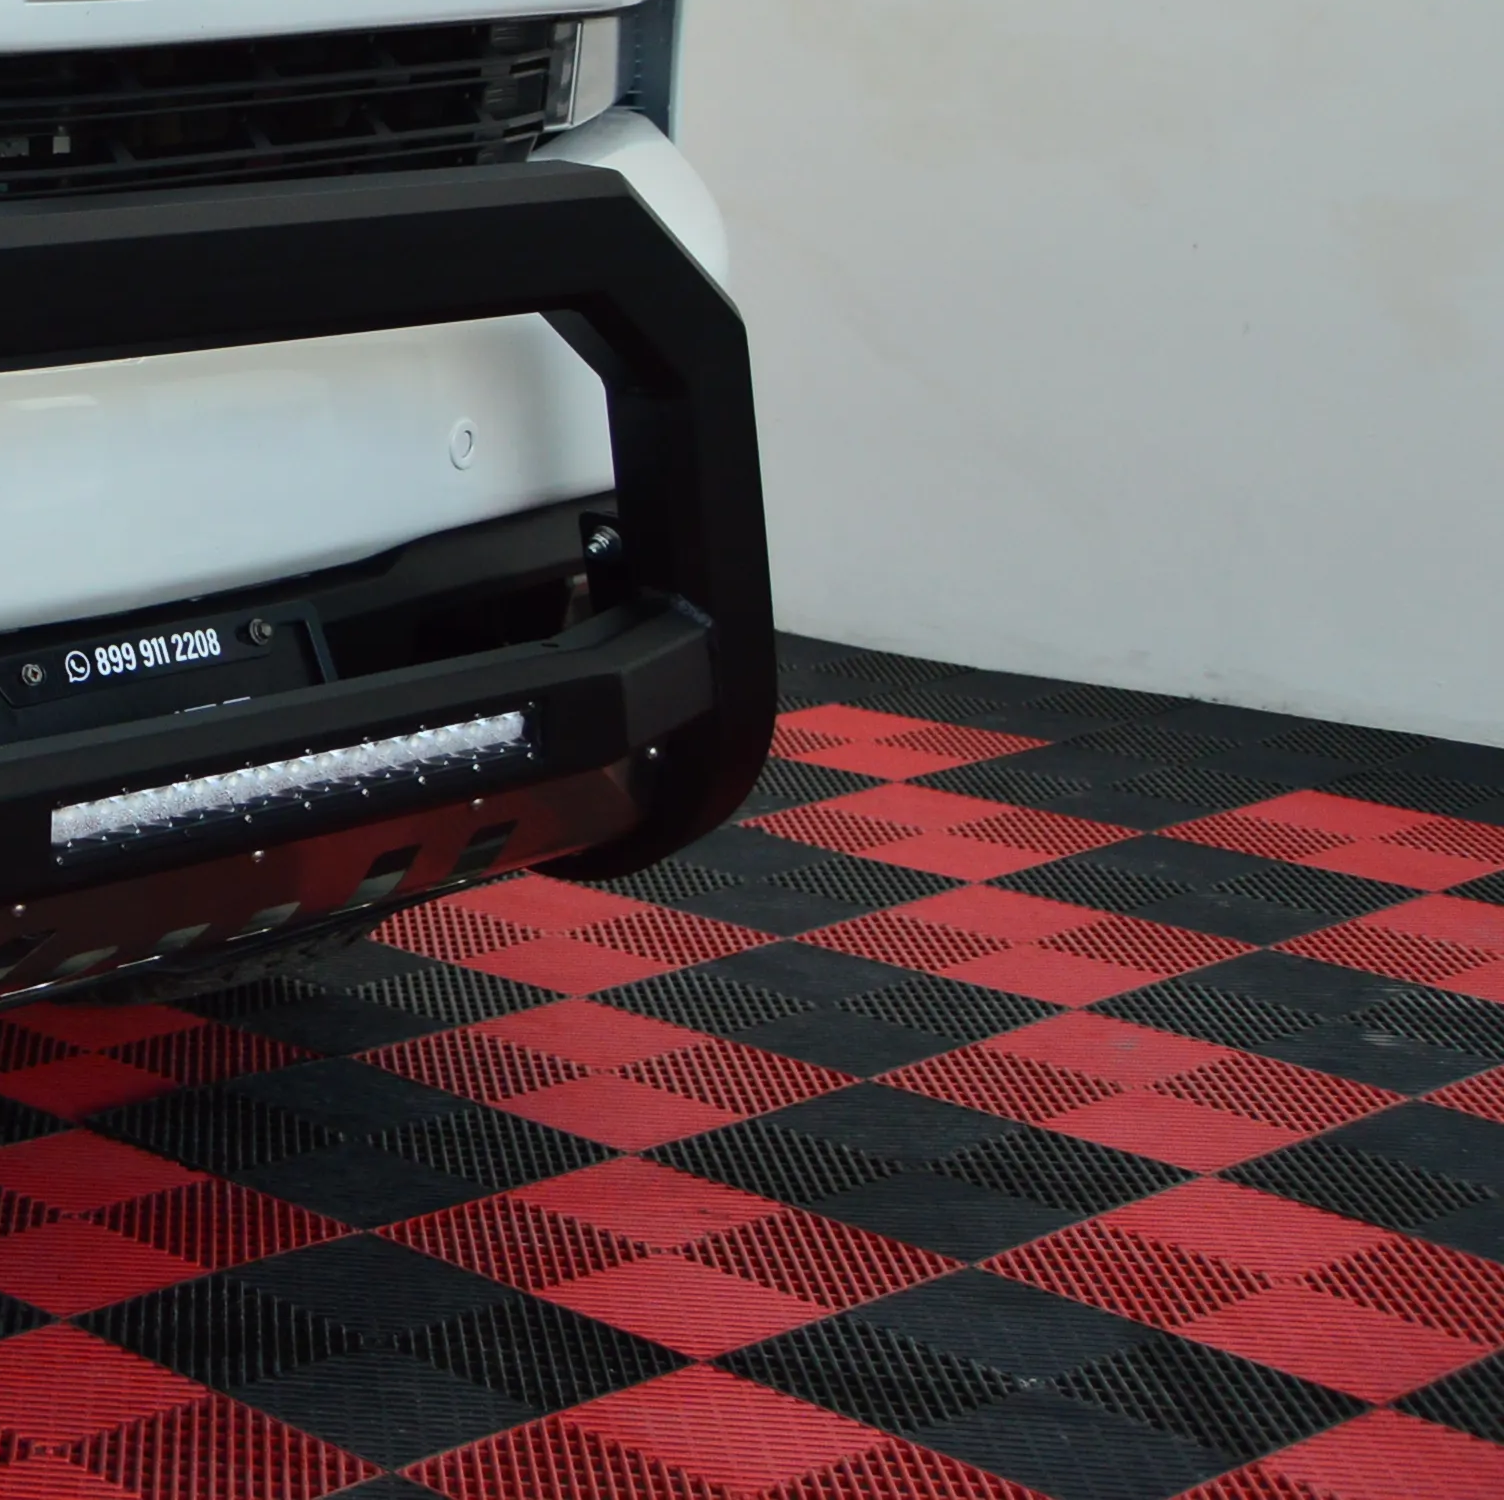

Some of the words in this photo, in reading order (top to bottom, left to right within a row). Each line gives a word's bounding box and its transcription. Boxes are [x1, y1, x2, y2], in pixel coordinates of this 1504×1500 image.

[94, 642, 137, 676] 899
[139, 636, 171, 668] 911
[171, 628, 221, 662] 2208
